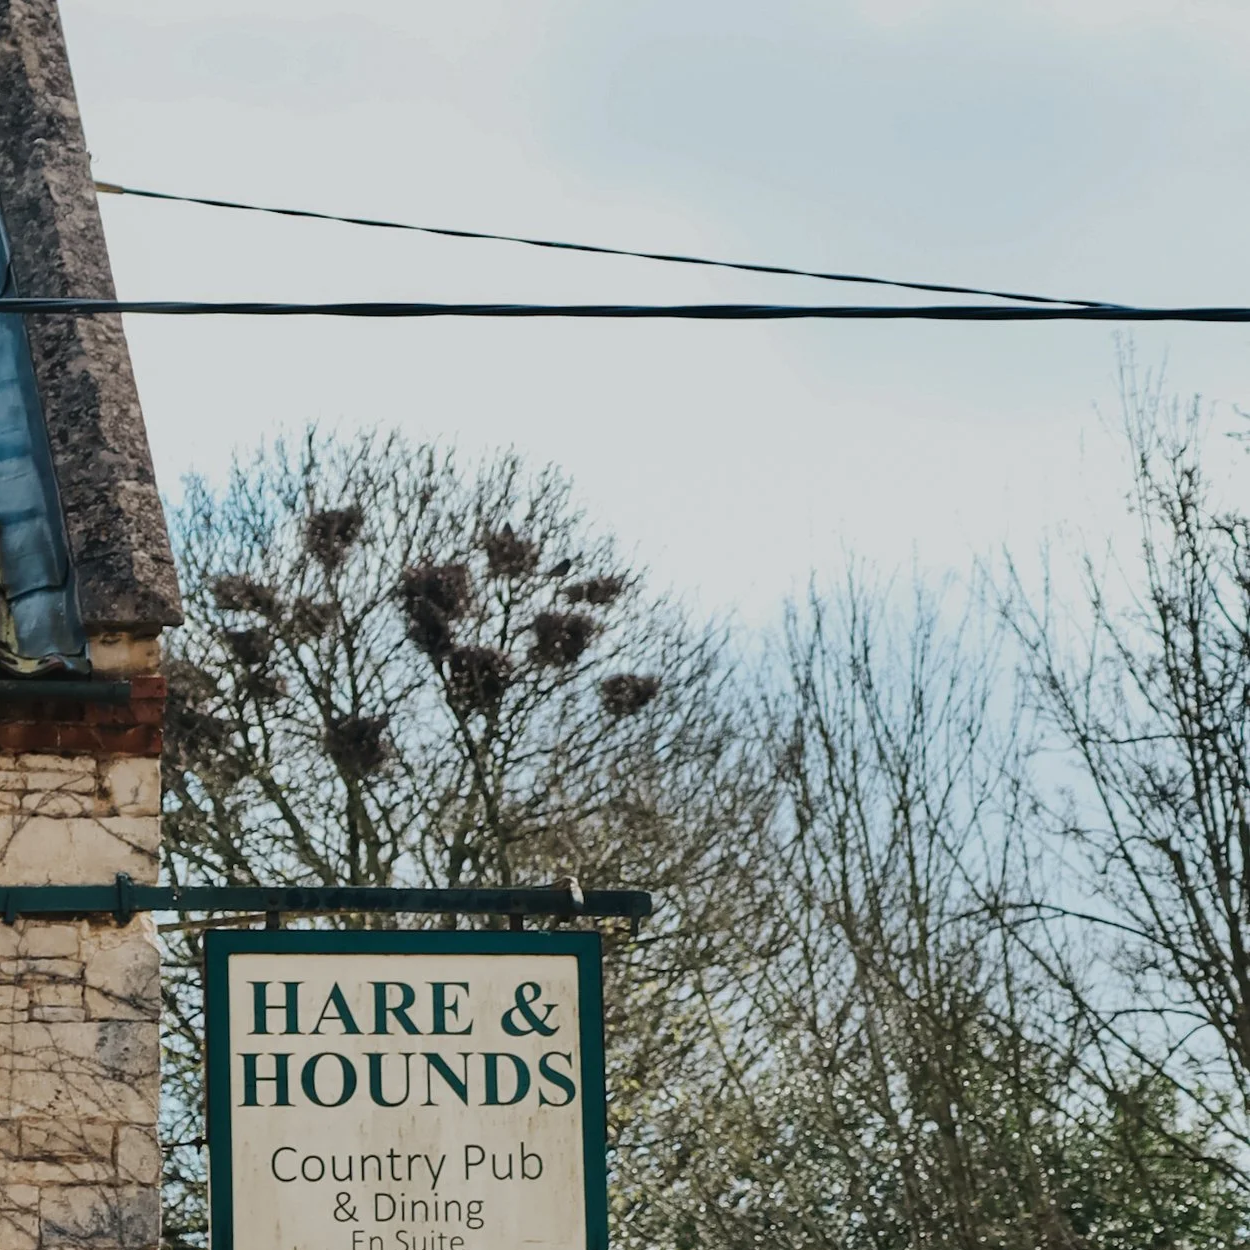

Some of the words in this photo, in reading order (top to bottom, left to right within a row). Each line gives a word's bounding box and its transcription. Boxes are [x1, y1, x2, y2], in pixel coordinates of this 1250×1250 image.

[246, 981, 474, 1036] HARE
[500, 981, 561, 1037] &
[237, 1051, 577, 1108] HOUNDS
[271, 1146, 446, 1190] Country
[464, 1141, 544, 1181] Pub
[333, 1191, 359, 1222] &
[374, 1192, 485, 1230] Dining
